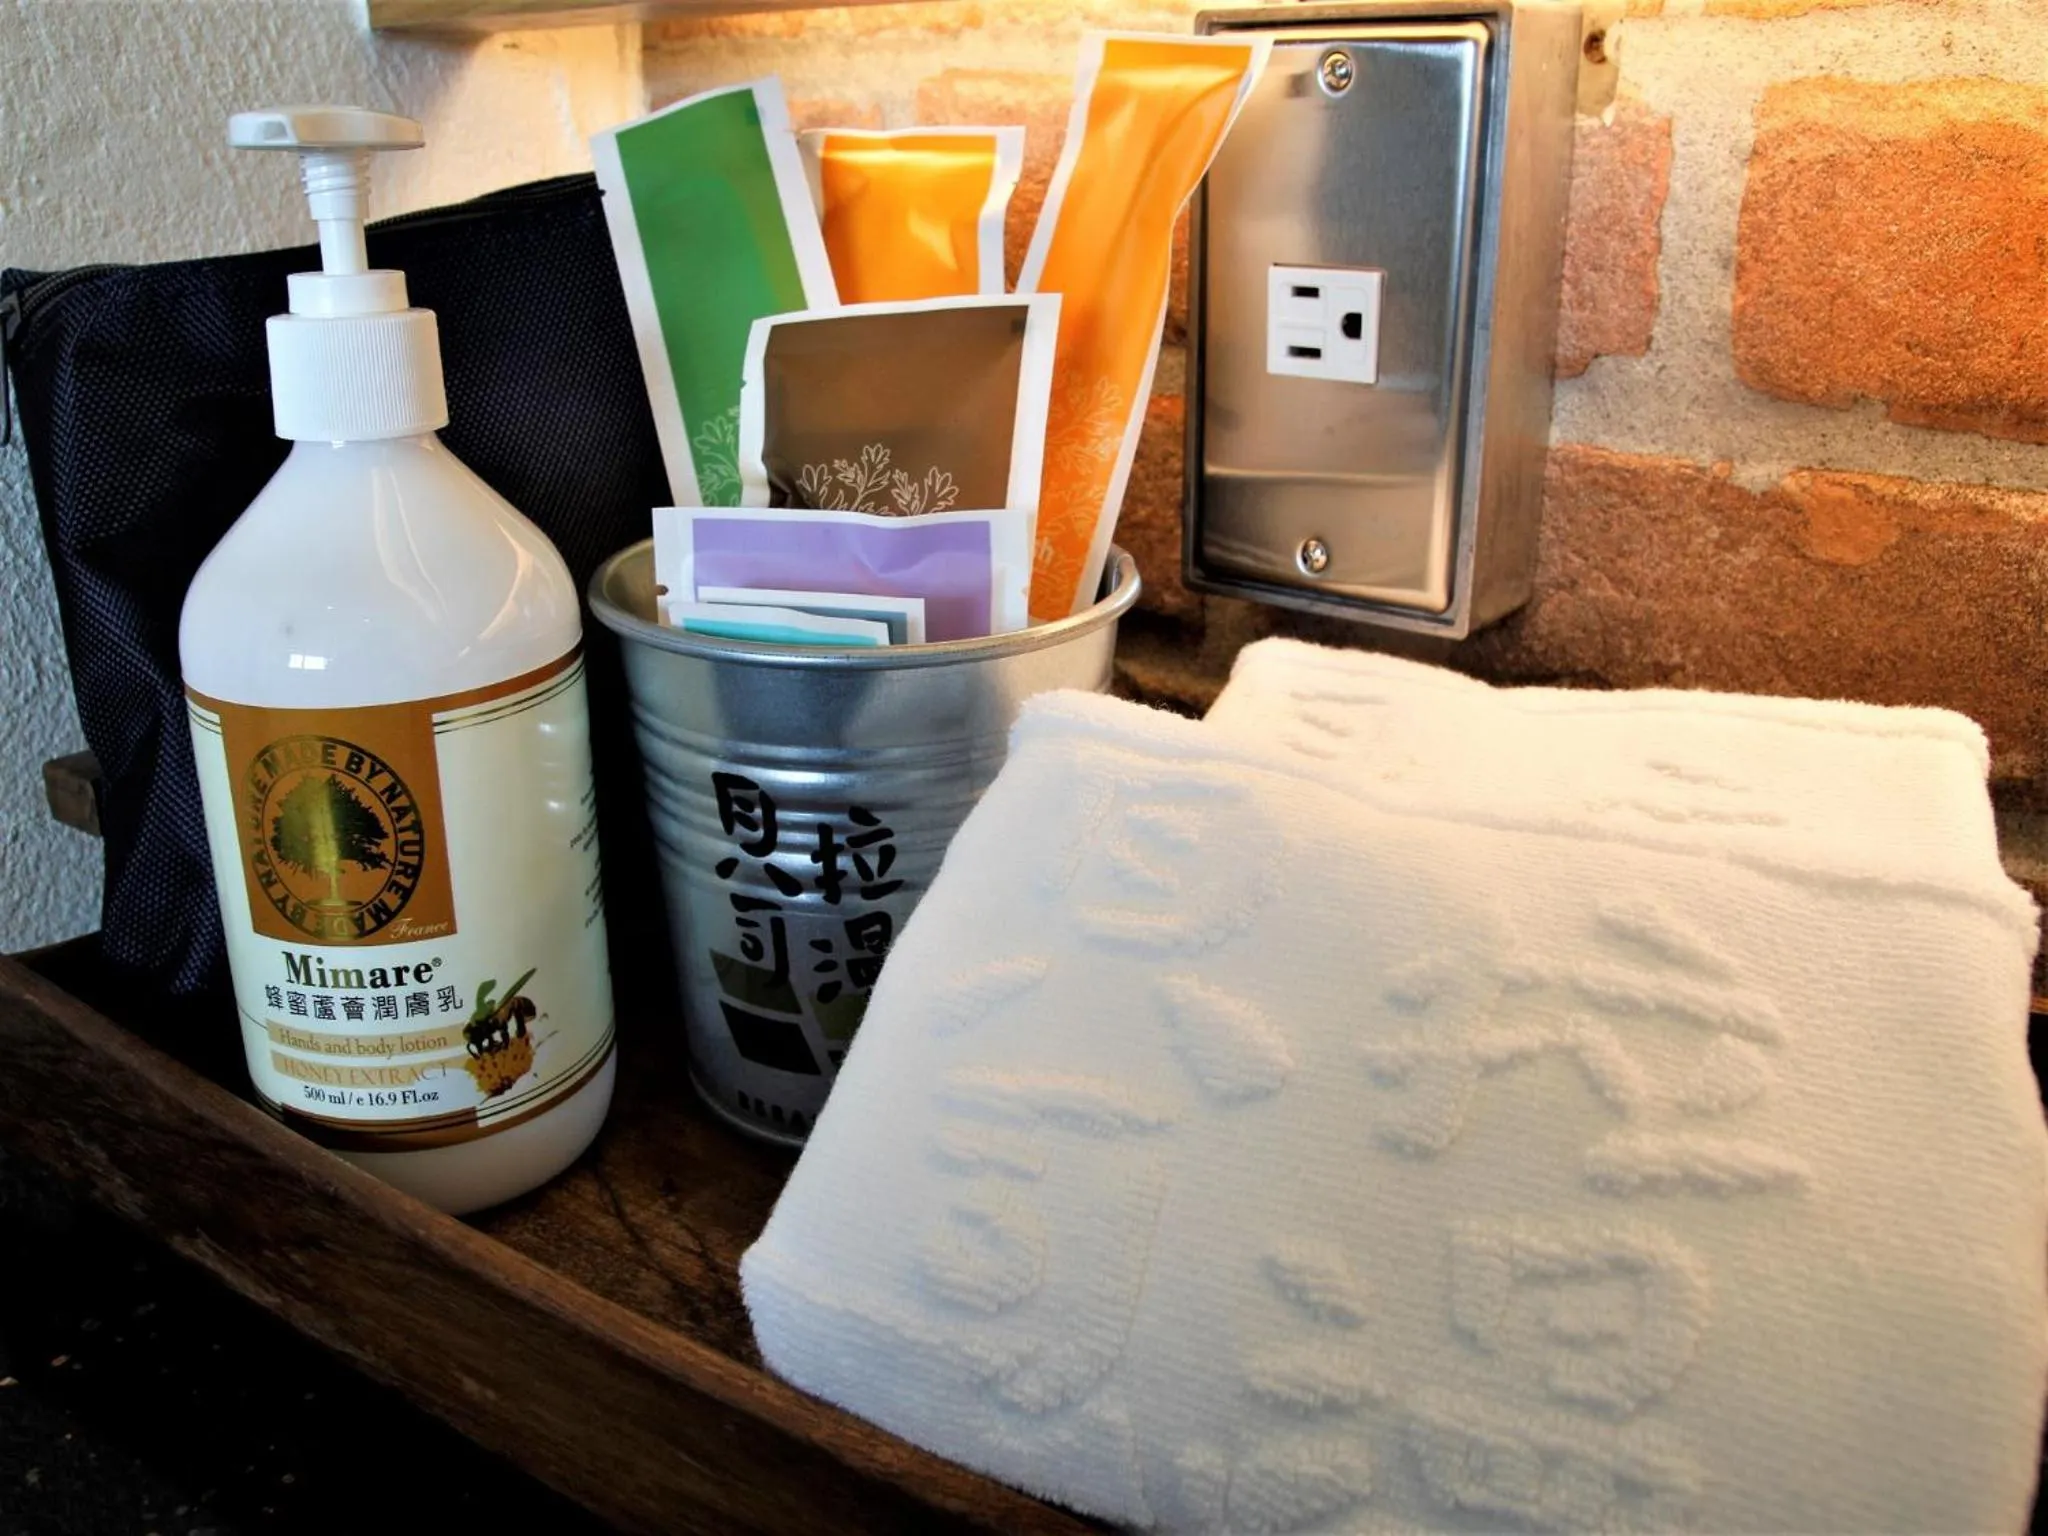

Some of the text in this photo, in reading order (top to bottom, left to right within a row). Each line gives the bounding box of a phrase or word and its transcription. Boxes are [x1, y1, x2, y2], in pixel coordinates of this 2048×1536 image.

[344, 749, 383, 787] BY
[379, 780, 422, 904] NATURE
[390, 917, 449, 940] France
[264, 983, 464, 1021] 蜂蜜蘆薈潤膚乳
[279, 1027, 447, 1059] Hands and body lotion
[283, 1059, 447, 1085] HONEY EXTRACT
[303, 1085, 326, 1101] 500
[369, 1091, 398, 1107] 16.9
